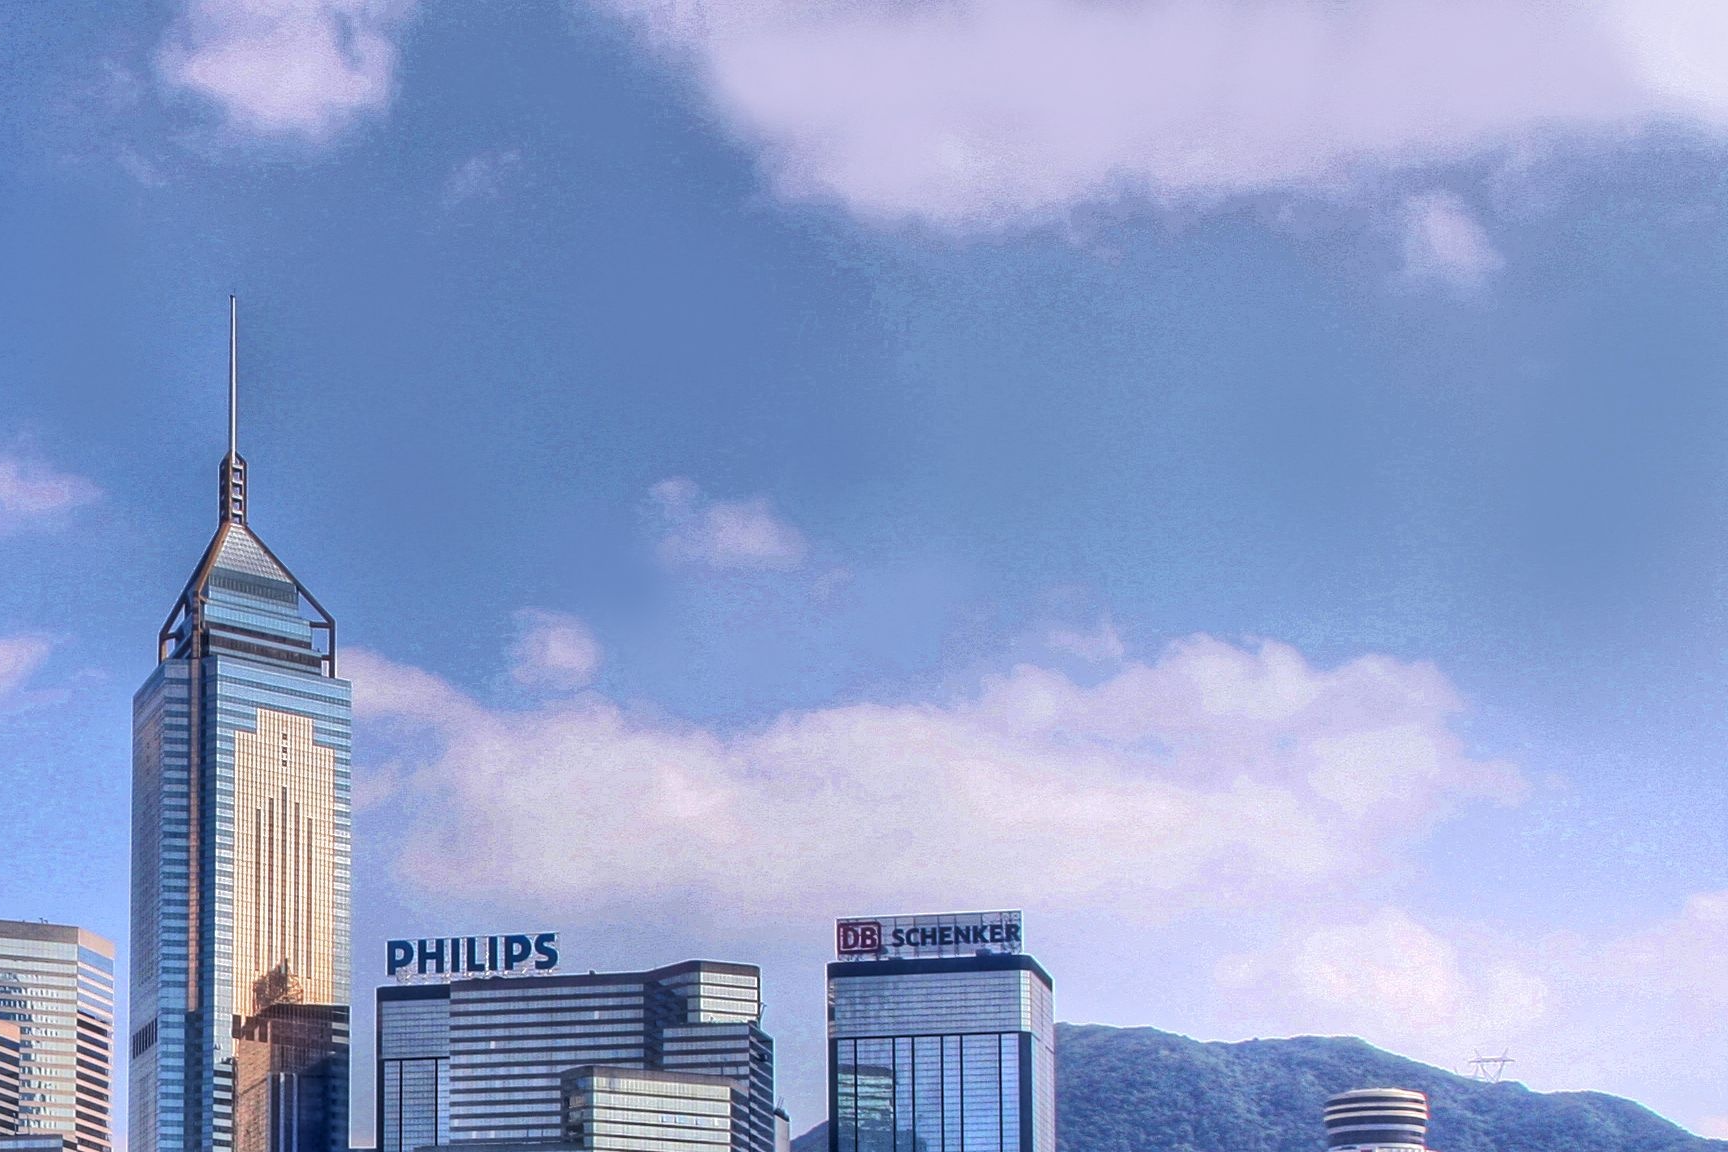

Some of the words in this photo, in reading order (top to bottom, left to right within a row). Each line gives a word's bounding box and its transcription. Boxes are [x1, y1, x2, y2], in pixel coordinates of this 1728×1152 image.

[386, 932, 560, 976] PHILIPS
[840, 924, 879, 951] DB
[891, 923, 1022, 948] SCHENKER
